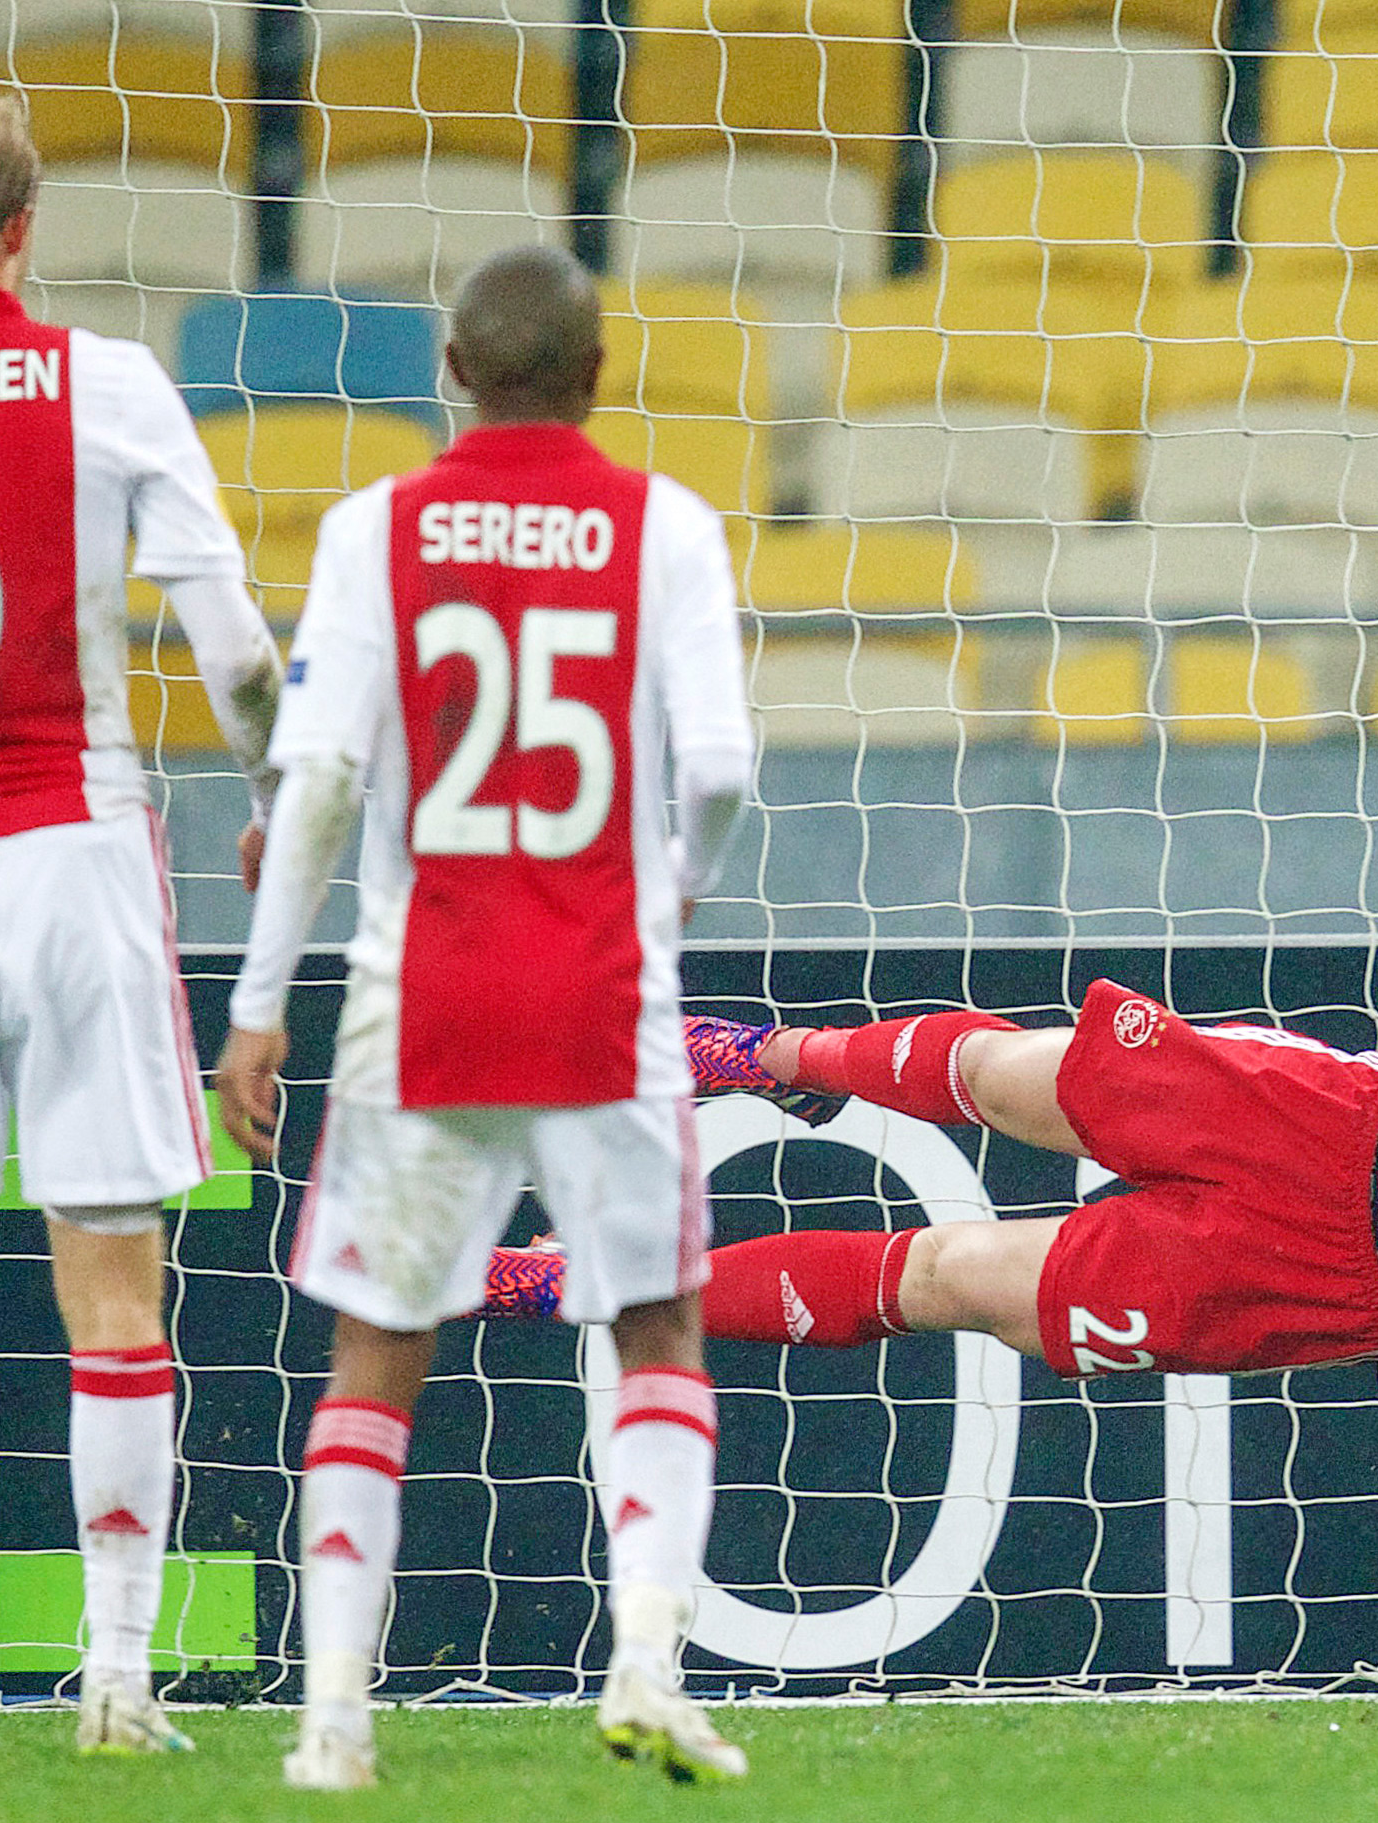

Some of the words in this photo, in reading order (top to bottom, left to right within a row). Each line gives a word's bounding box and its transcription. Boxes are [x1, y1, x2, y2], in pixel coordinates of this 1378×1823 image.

[418, 501, 614, 571] SERERO
[413, 602, 618, 860] 25
[1069, 1306, 1155, 1374] 22
